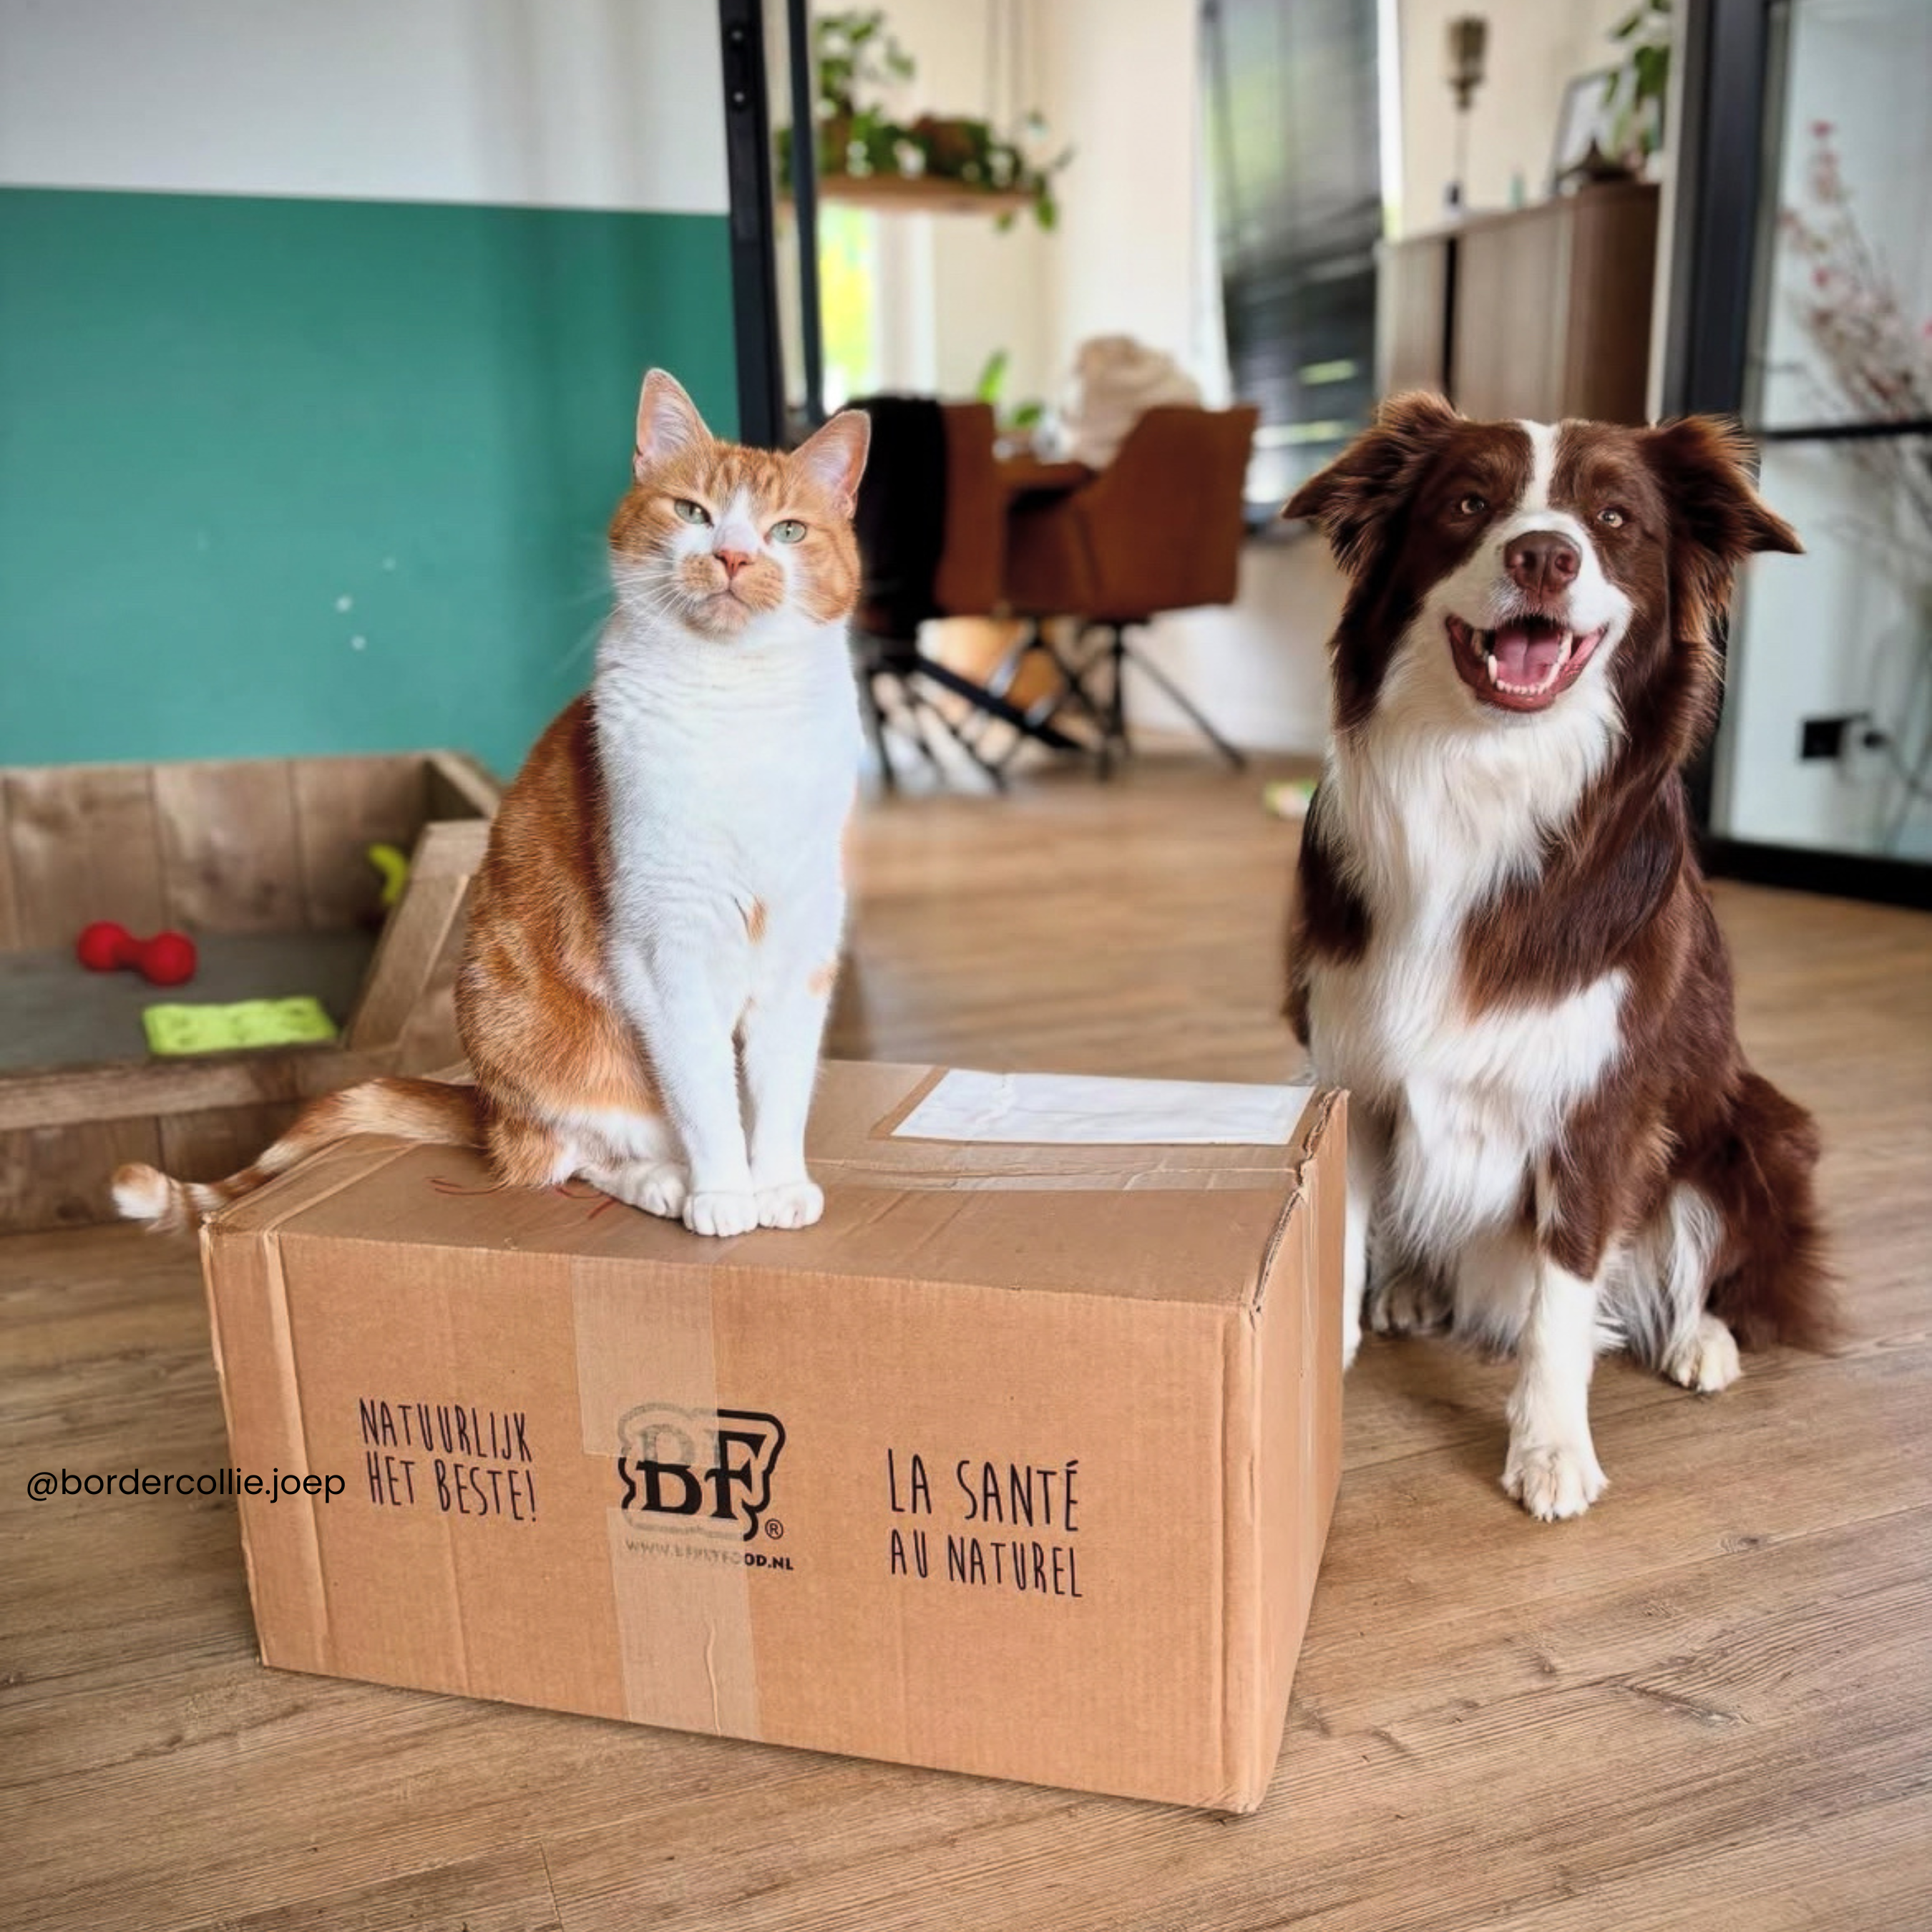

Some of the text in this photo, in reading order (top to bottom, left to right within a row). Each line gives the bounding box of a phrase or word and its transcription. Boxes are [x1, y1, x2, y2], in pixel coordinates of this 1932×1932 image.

[359, 1397, 532, 1463] NATUURLIJK
[367, 1450, 536, 1522] HET BESTE!
[888, 1448, 1078, 1531] LA SANTÉ
[892, 1528, 1083, 1598] AU NATUREL
